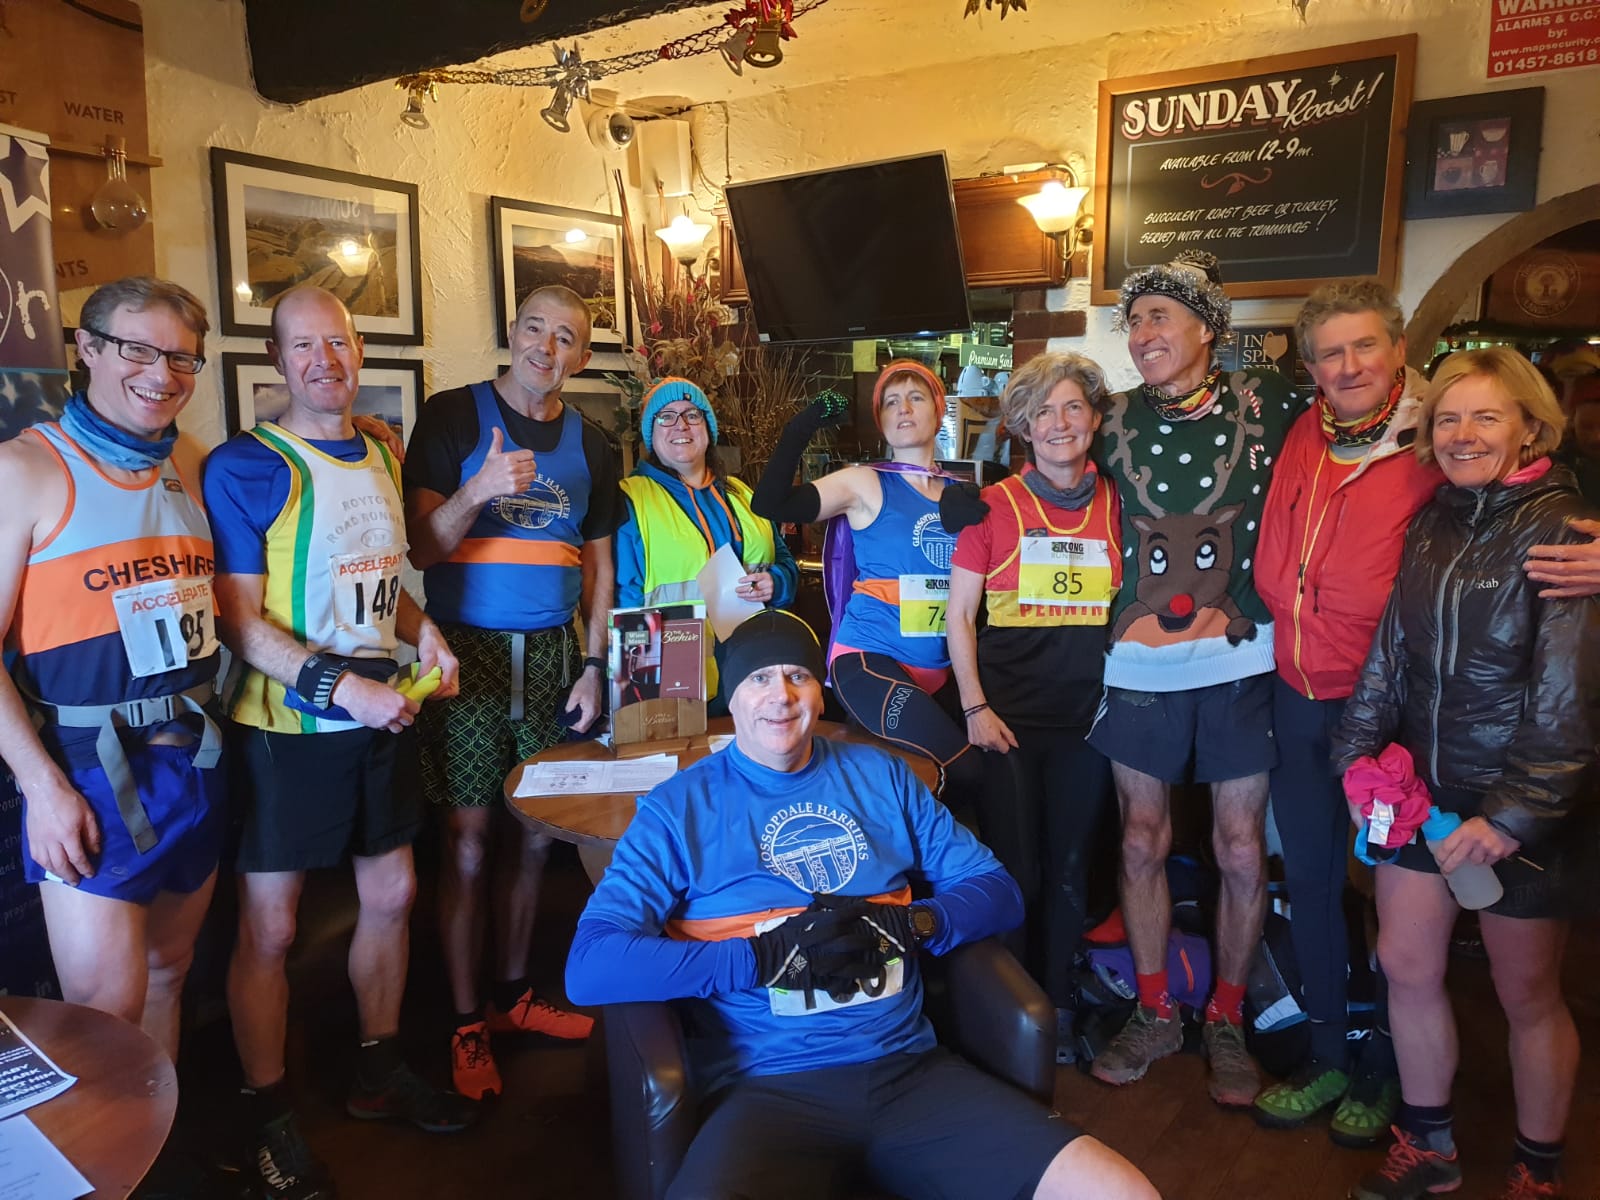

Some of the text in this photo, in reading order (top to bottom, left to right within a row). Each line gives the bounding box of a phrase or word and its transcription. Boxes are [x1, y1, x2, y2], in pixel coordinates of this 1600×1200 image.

[1495, 9, 1600, 32] ALARMS & C.C.
[1548, 28, 1568, 38] by:
[64, 100, 124, 125] WATER
[1123, 79, 1302, 137] SUNDAY
[1160, 153, 1221, 171] AVAILABLE
[1222, 149, 1256, 164] FROM
[1143, 208, 1206, 225] SUCCULENT
[1206, 206, 1243, 221] ROAST
[1240, 203, 1273, 221] BEEF
[1274, 203, 1292, 219] OR
[1139, 231, 1176, 248] SERVED
[1177, 229, 1203, 242] WITH
[1203, 227, 1223, 240] ALL
[1224, 226, 1248, 239] THE
[1248, 221, 1312, 237] TRIMMINGS
[1243, 334, 1264, 348] IN
[545, 477, 571, 520] HARRIER
[326, 515, 359, 545] ROAD
[1052, 571, 1083, 595] 85
[1475, 577, 1499, 590] Rab
[355, 575, 399, 625] 148
[886, 687, 913, 729] OMM
[817, 804, 869, 861] HARRIERS
